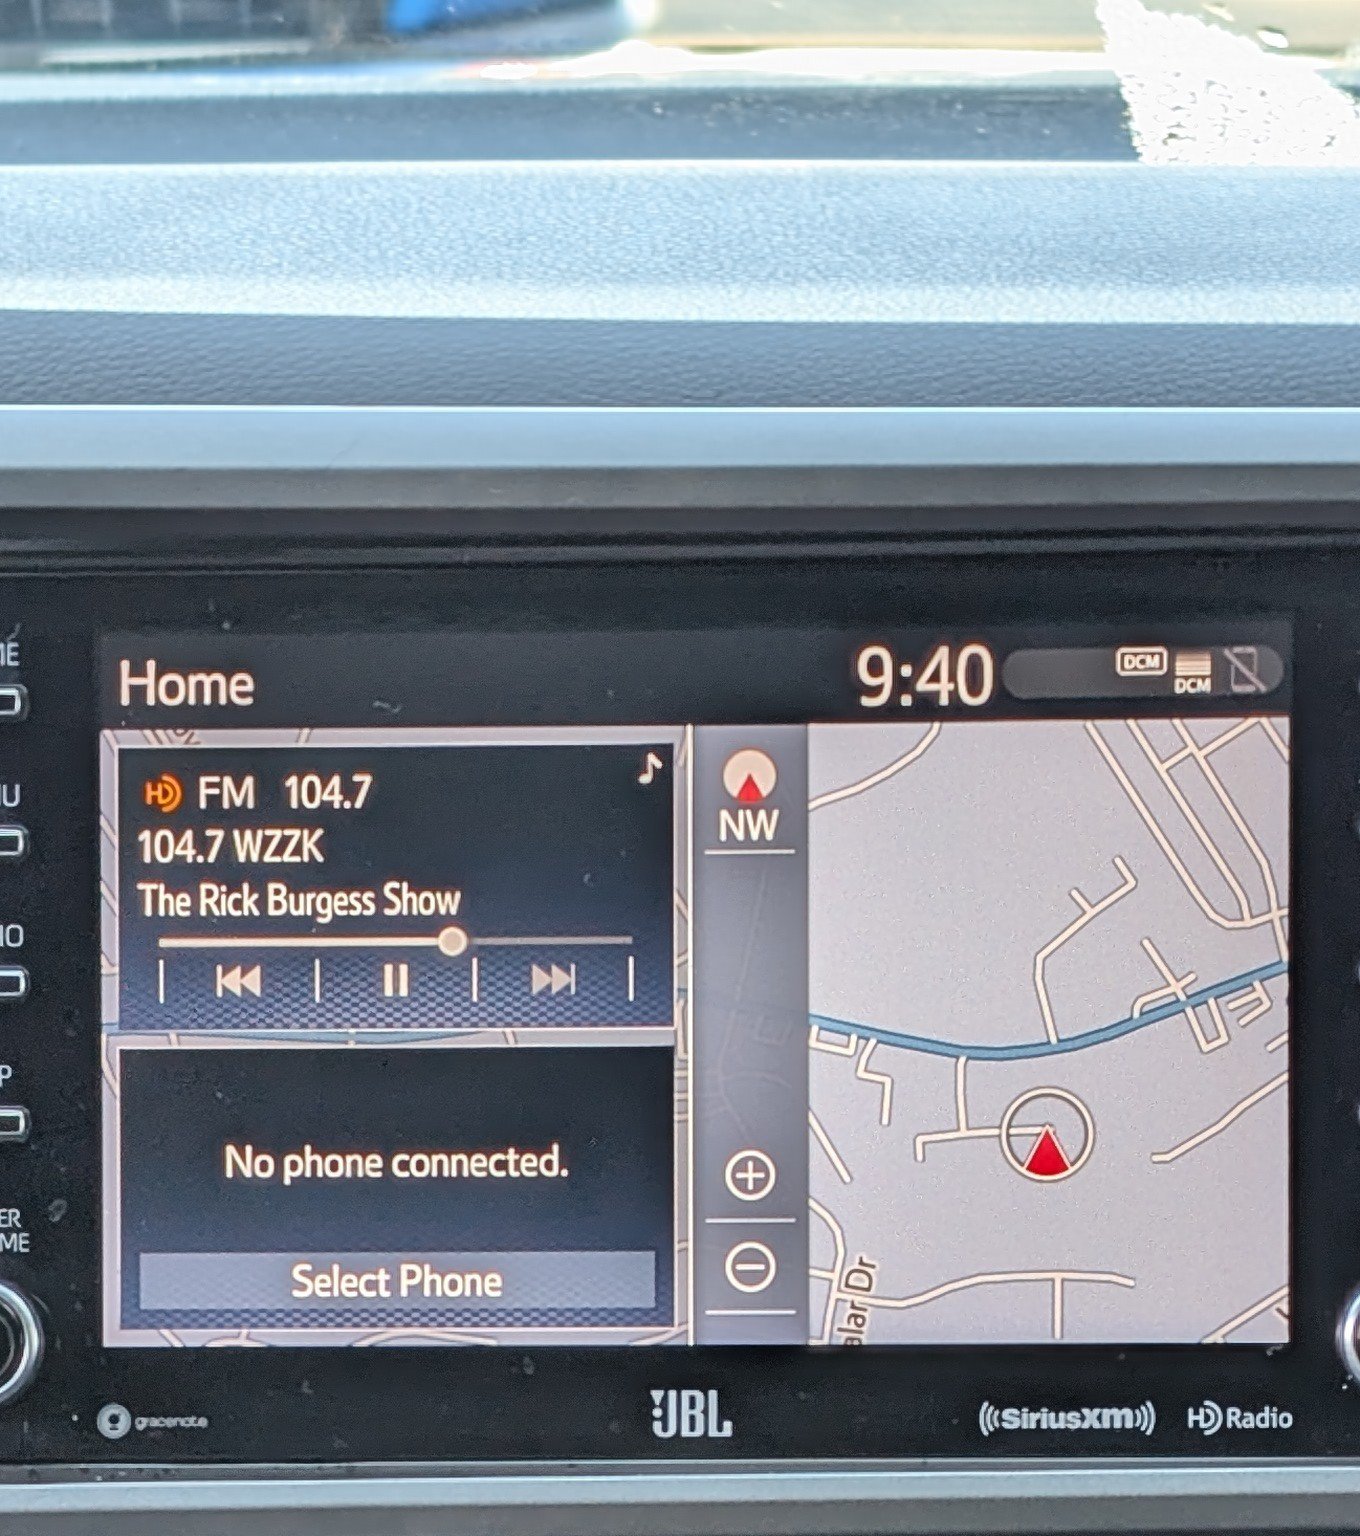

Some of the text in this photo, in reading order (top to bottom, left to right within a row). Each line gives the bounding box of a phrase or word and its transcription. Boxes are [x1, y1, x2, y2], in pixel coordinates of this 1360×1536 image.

[856, 644, 994, 707] 9:40
[1124, 654, 1160, 670] DCM
[119, 660, 254, 707] Home
[1174, 677, 1211, 694] DCM
[198, 775, 256, 810] FM
[284, 774, 373, 809] 104.7
[719, 809, 779, 841] NW
[138, 829, 325, 863] 104.7 WZZK
[137, 881, 461, 924] The Rick Burgess Show
[224, 1144, 569, 1185] No phone connected.
[291, 1263, 502, 1299] Select Phone
[845, 1256, 876, 1292] Dr
[650, 1389, 733, 1438] JBL
[1226, 1406, 1294, 1429] Radio
